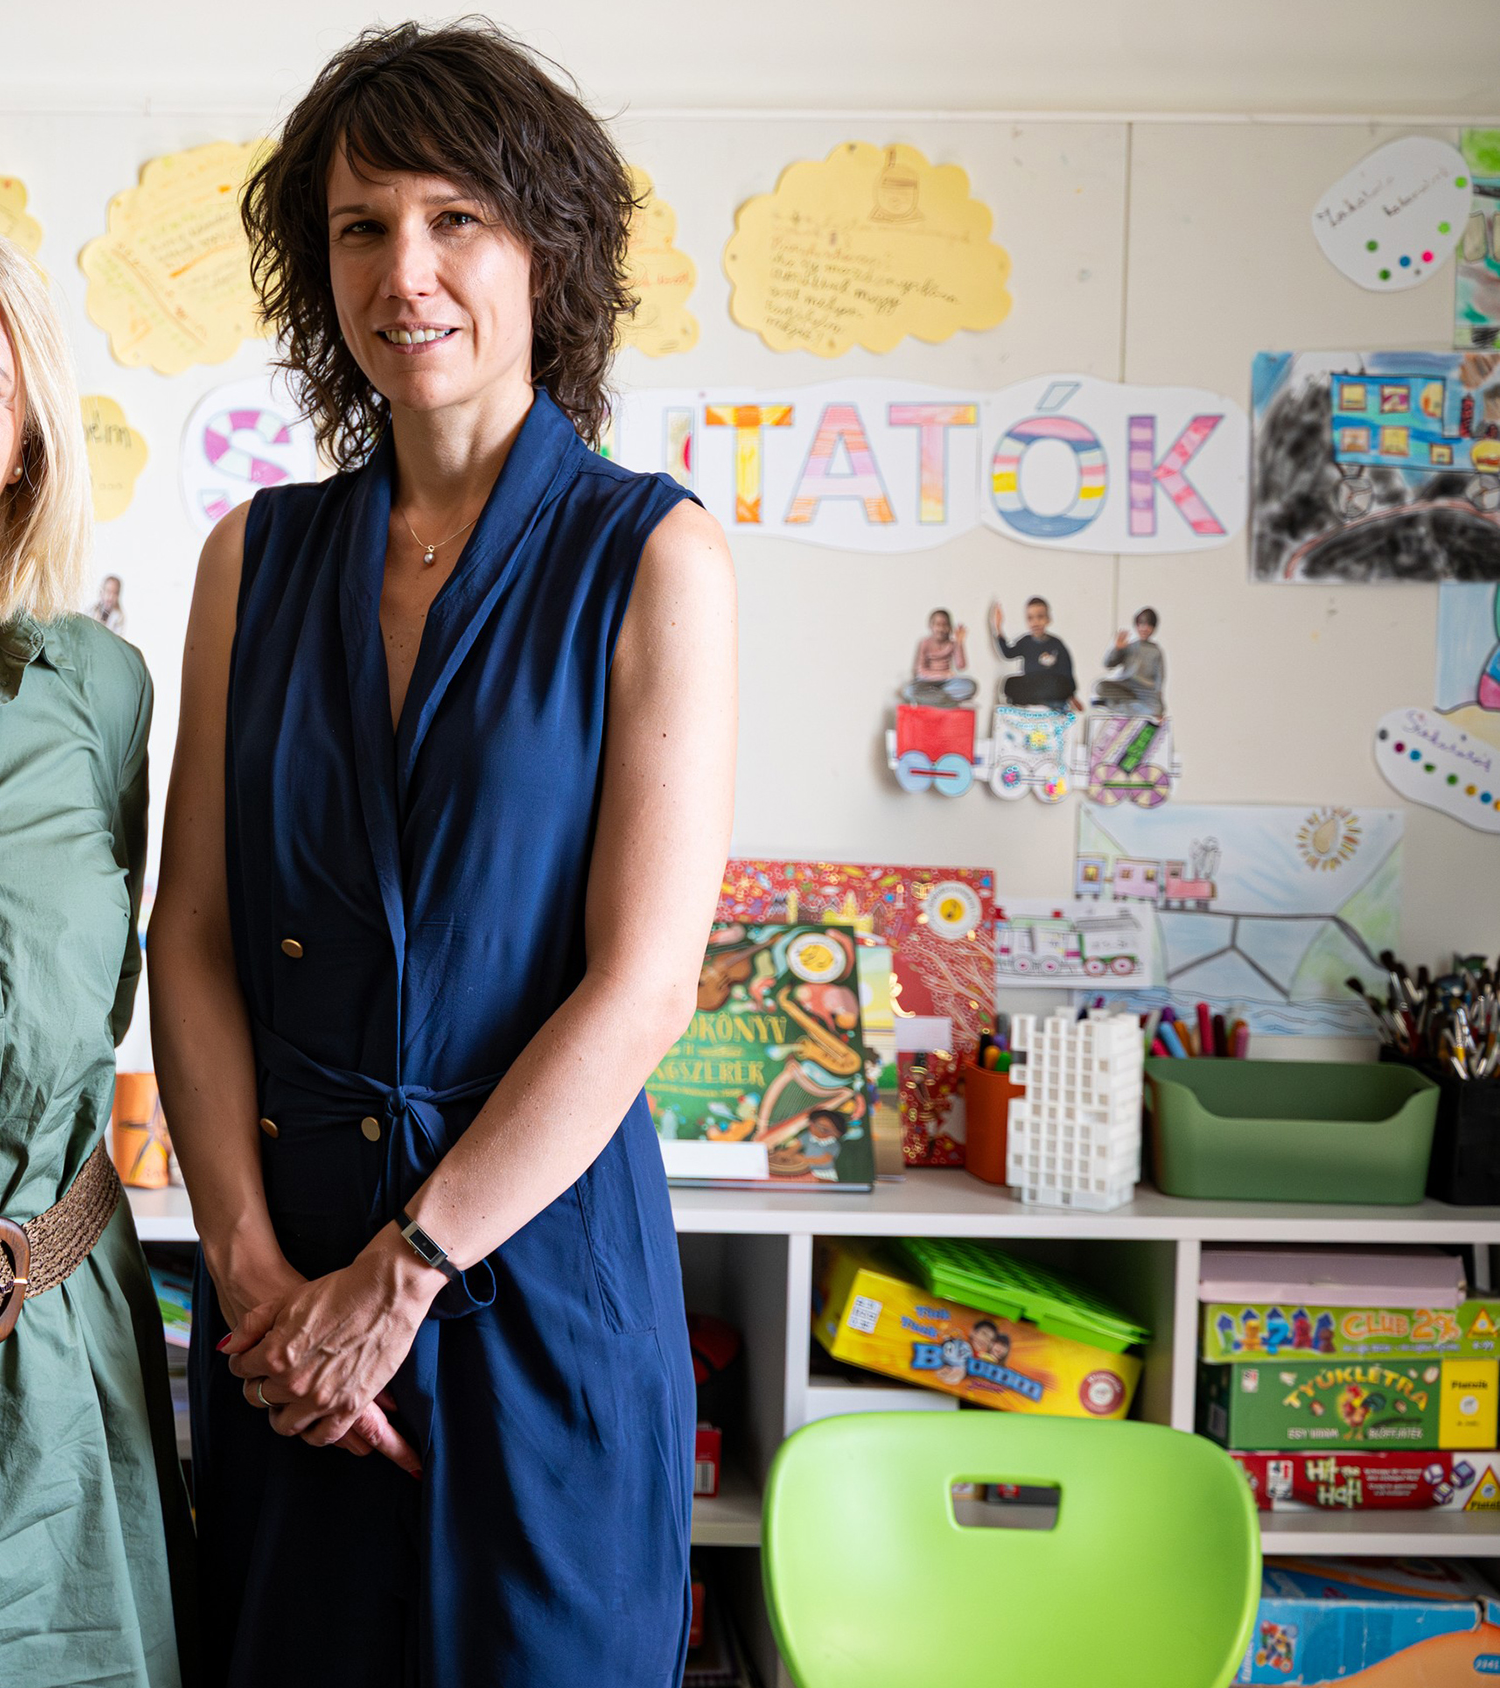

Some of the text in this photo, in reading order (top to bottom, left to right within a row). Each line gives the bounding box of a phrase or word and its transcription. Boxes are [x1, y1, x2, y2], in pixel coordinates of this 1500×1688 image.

[683, 1011, 788, 1043] KÖNYV
[654, 1059, 766, 1087] GSZEREK
[1343, 1312, 1408, 1339] CLUB
